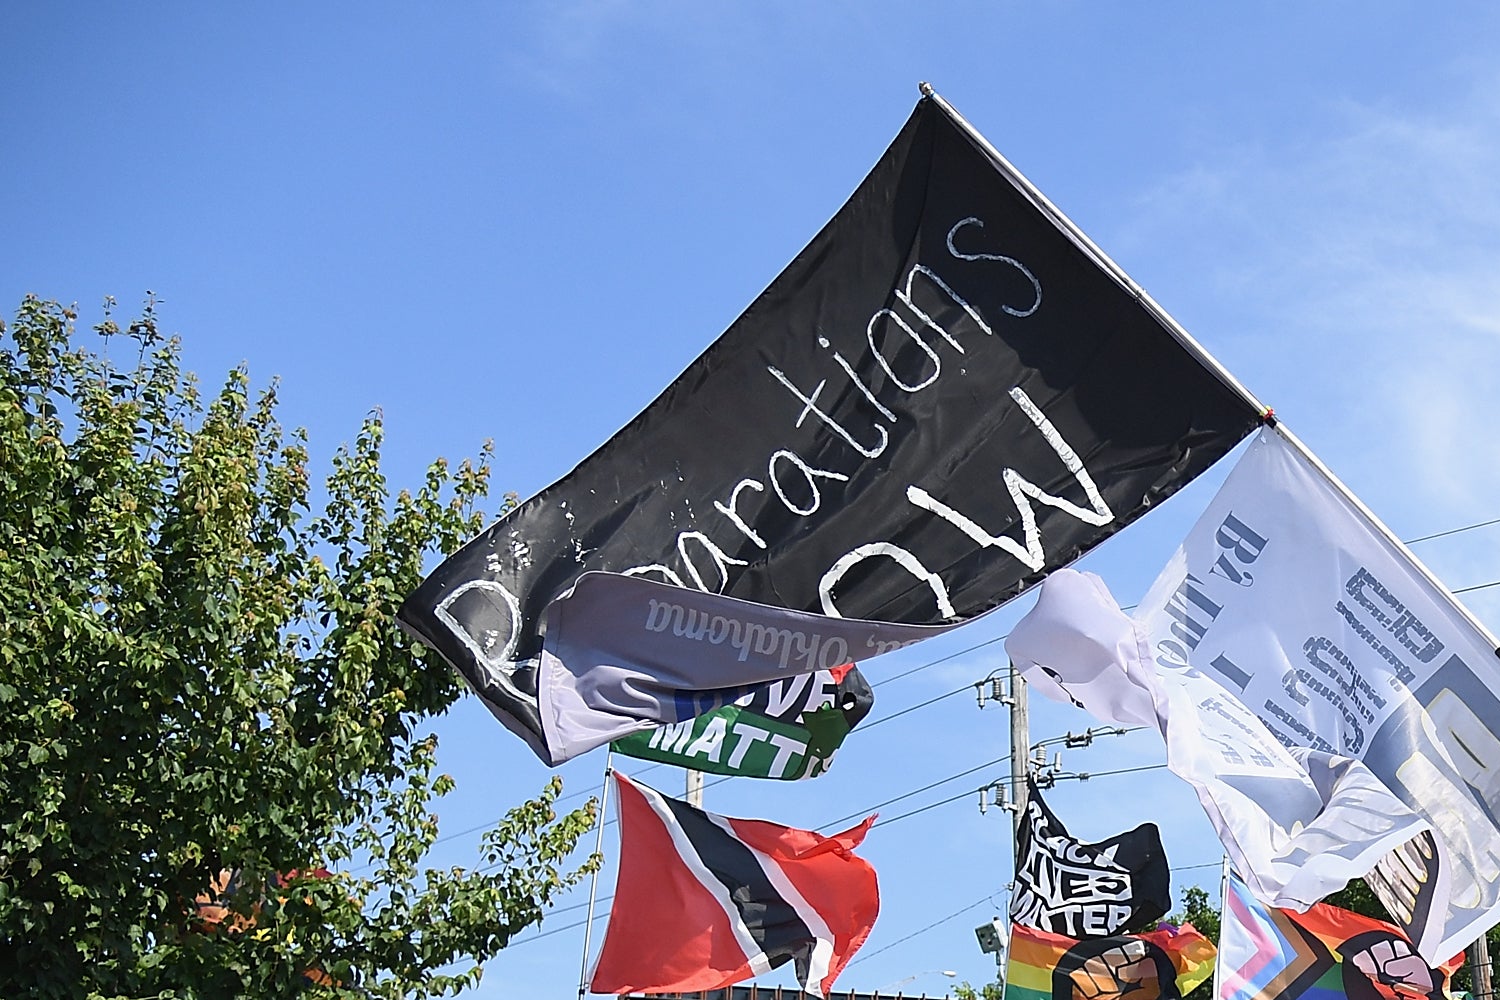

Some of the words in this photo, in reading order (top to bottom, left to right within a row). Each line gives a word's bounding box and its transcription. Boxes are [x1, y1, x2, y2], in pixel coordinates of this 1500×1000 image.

[435, 216, 1043, 703] Rarations
[818, 387, 1115, 620] OW
[645, 599, 854, 671] Oklahoma
